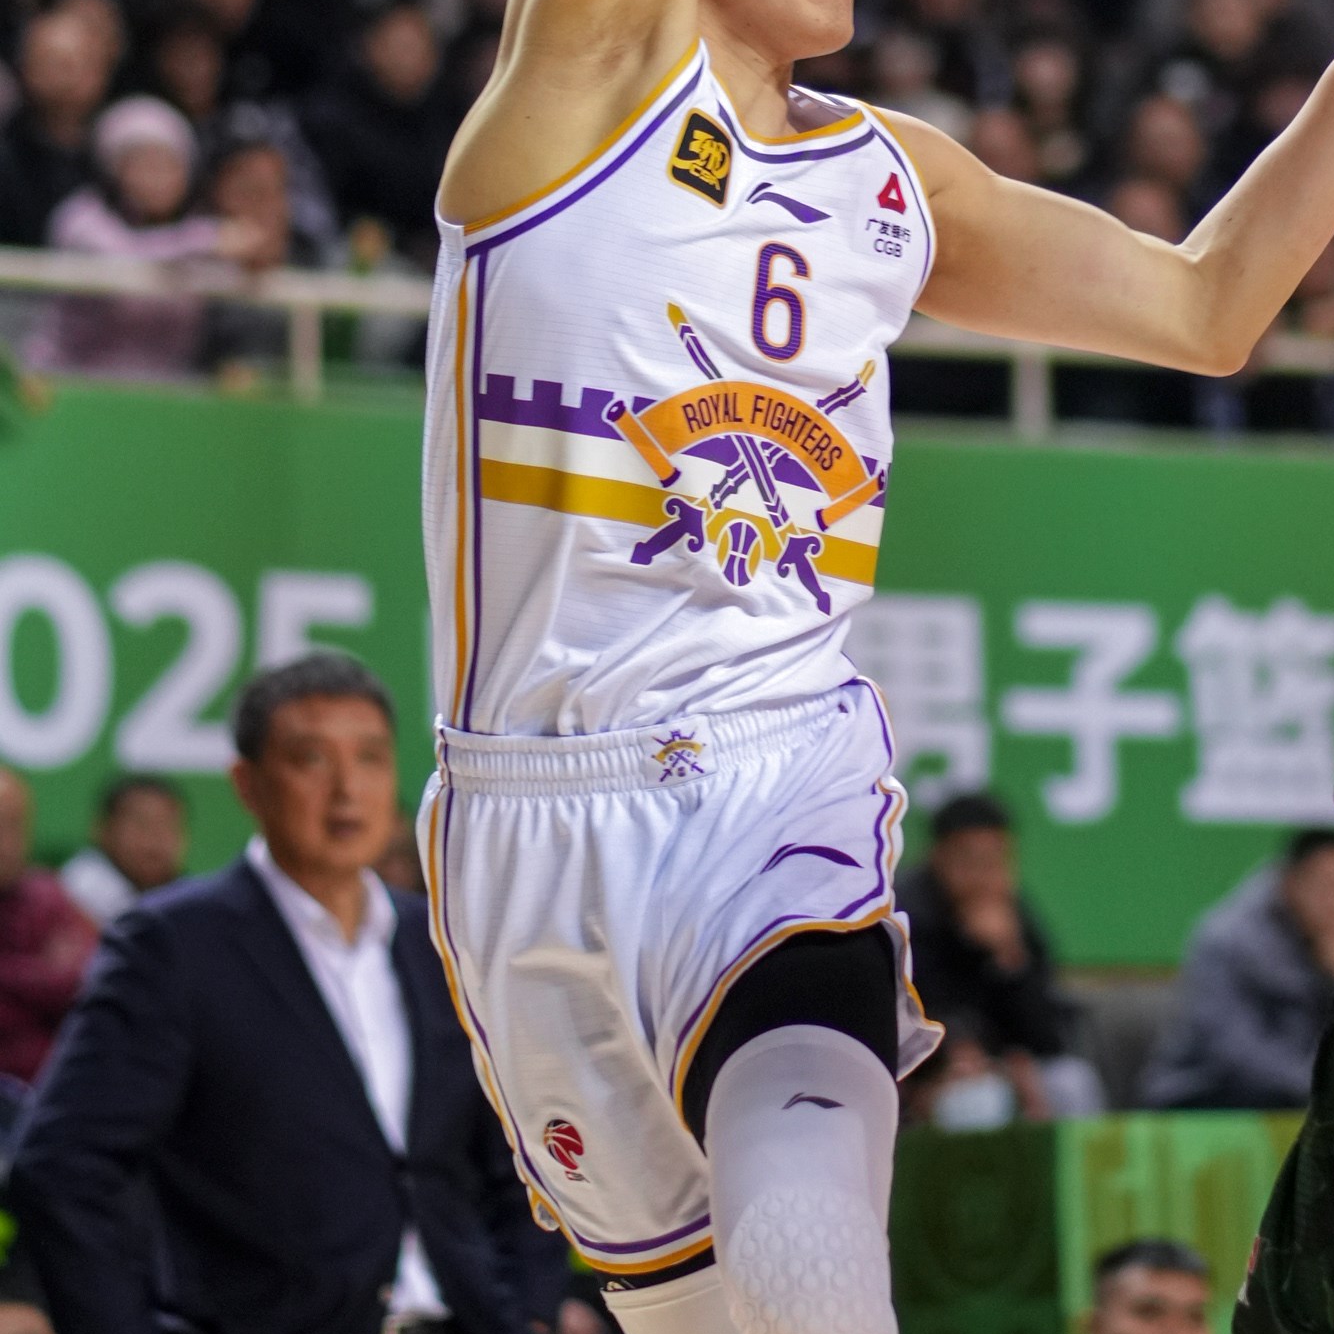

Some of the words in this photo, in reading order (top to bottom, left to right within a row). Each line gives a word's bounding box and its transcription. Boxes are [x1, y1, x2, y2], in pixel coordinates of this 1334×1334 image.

[873, 238, 903, 258] CGB
[752, 240, 812, 364] 6
[681, 392, 744, 434] ROYAL
[750, 394, 843, 472] FIGHTERS
